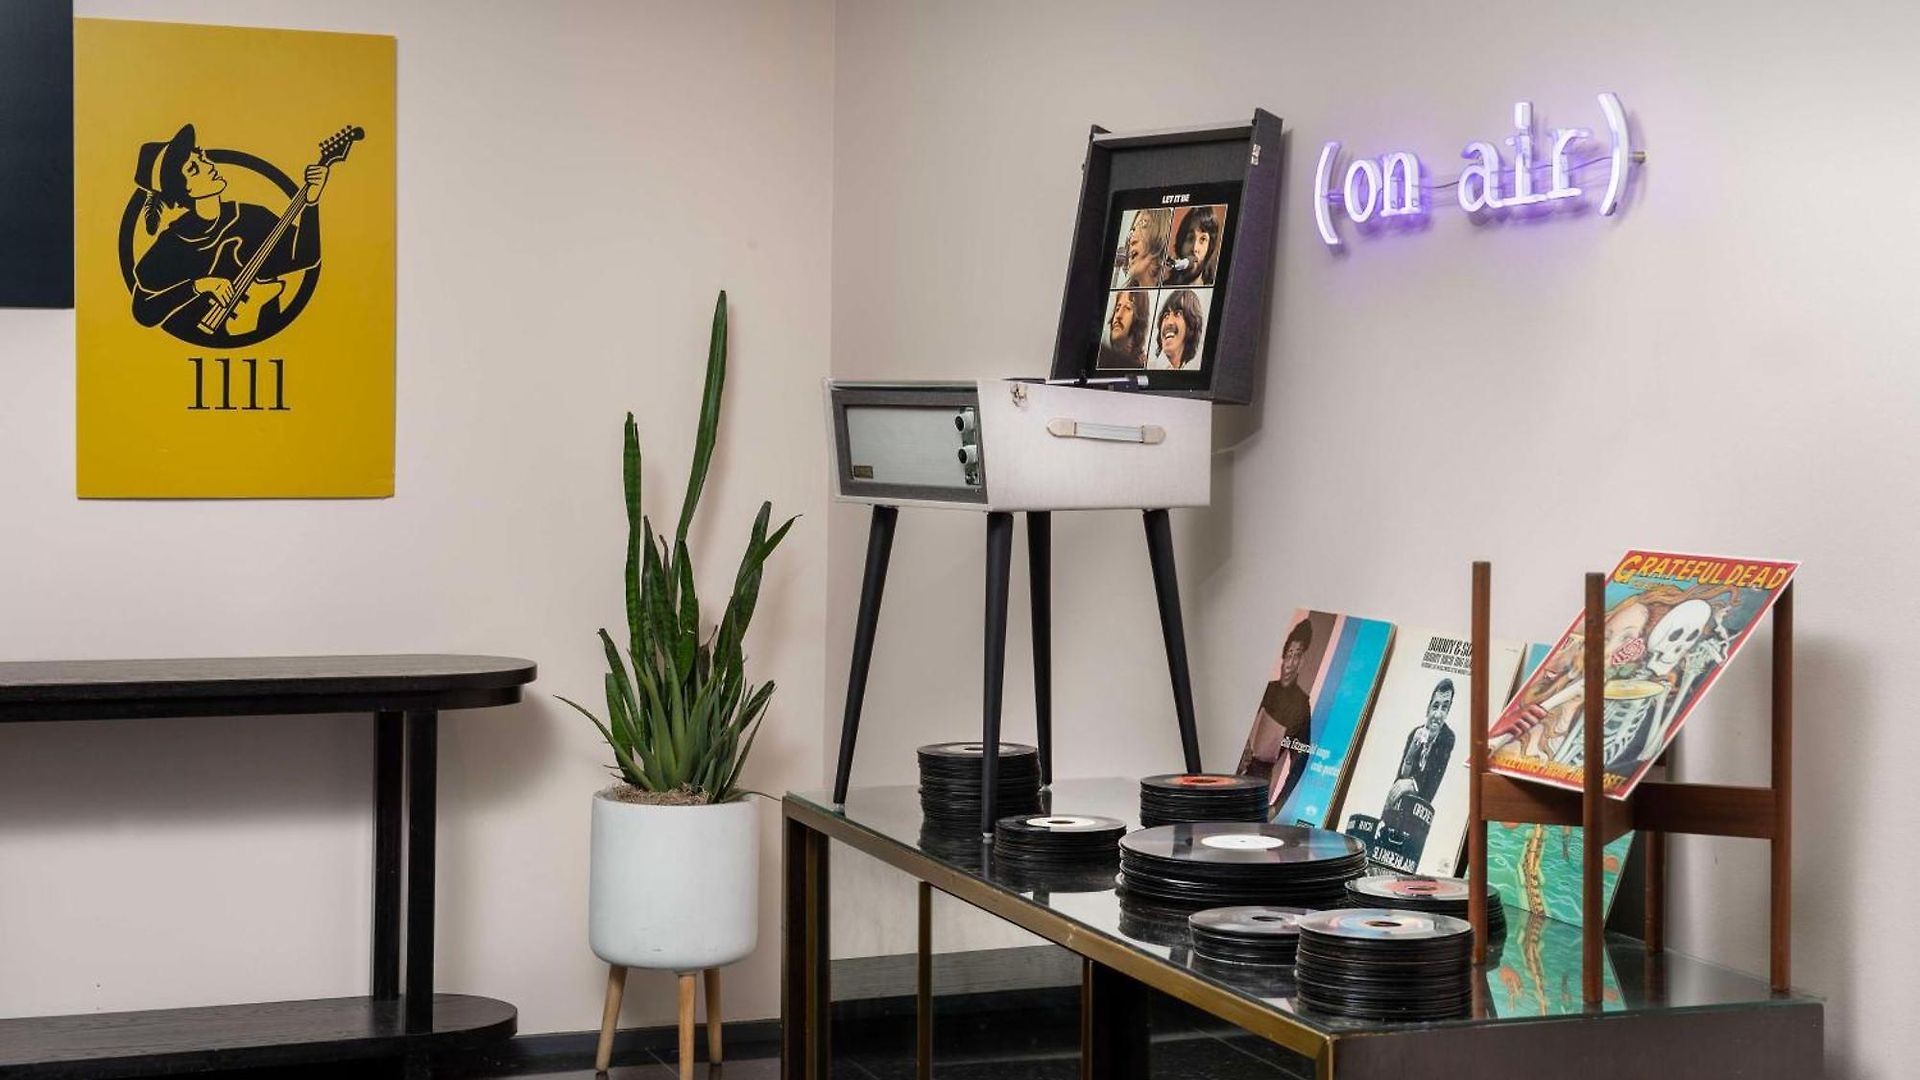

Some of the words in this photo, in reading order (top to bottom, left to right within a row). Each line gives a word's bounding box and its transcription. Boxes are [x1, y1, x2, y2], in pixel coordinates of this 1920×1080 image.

[1162, 195, 1174, 204] LET
[1173, 194, 1182, 203] IT
[1181, 193, 1191, 202] BE
[187, 357, 292, 411] 1111
[1613, 554, 1728, 585] GRATEFUL
[1724, 564, 1788, 590] DEAD
[1428, 636, 1457, 654] BUDDY
